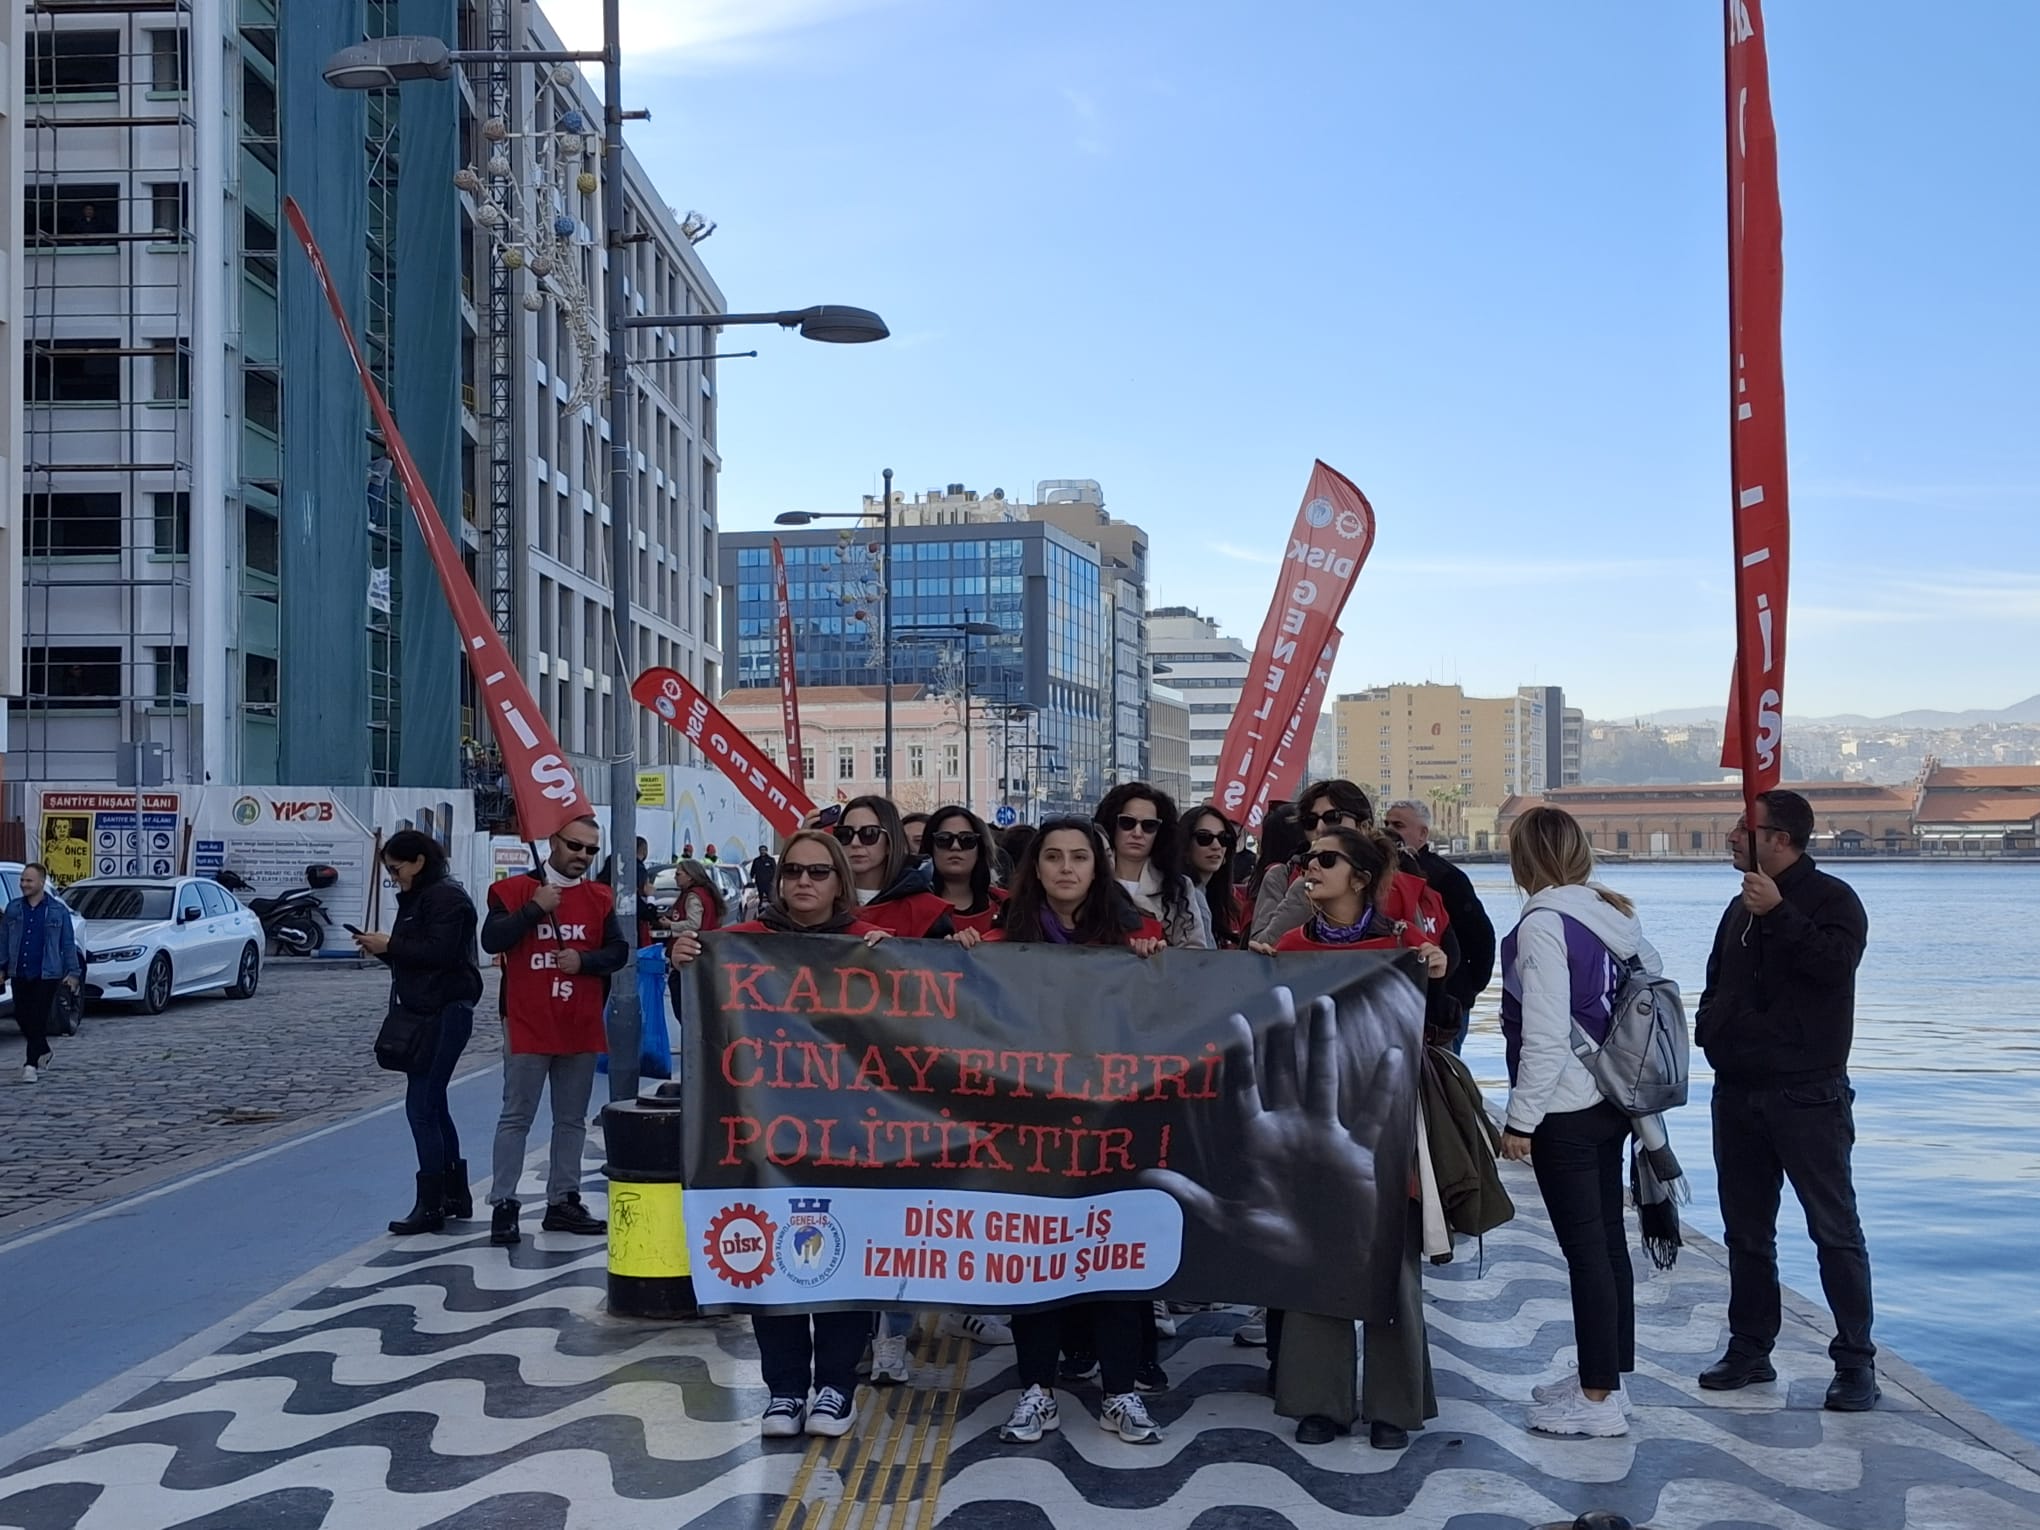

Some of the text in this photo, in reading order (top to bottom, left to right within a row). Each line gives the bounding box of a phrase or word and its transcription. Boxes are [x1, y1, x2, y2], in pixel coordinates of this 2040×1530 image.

[50, 795, 95, 808] ŞANTİYE
[141, 797, 171, 808] ALANI
[65, 845, 87, 856] ÖNCE
[552, 977, 574, 1001] İŞ
[720, 963, 964, 1018] KADIN
[721, 1029, 1224, 1101] CİNAYETLERİ
[719, 1107, 1138, 1177] POLİTİKTİR
[790, 1214, 829, 1228] GENEL-İŞ
[905, 1200, 1113, 1245] DİSK GENEL-İŞ
[722, 1232, 764, 1255] DİSK
[865, 1238, 1147, 1284] İZMİR 6 NO'LU ŞUBE
